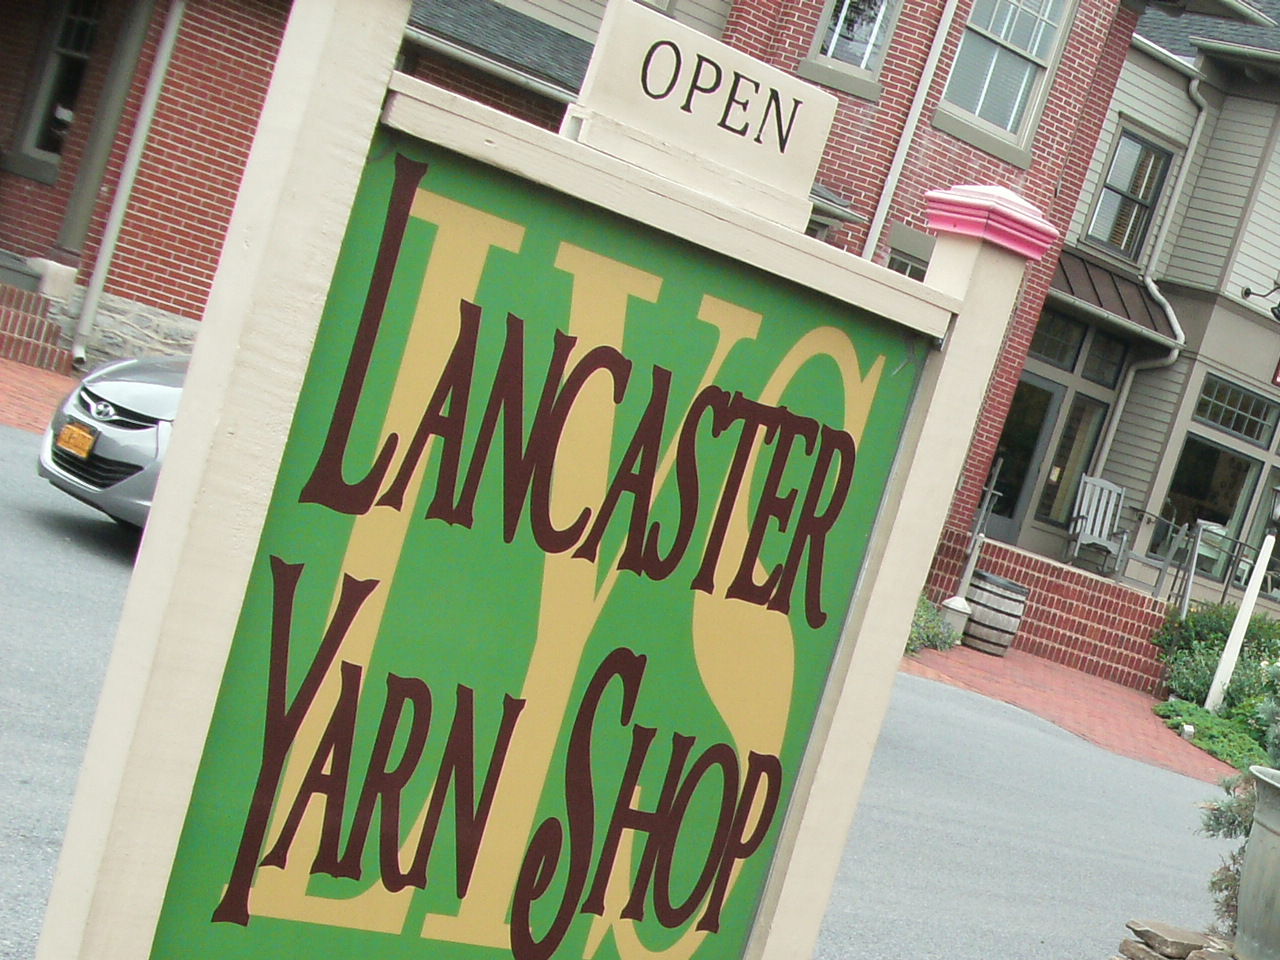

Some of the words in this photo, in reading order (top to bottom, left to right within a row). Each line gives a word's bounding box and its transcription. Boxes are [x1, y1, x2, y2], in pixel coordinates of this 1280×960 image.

[641, 40, 804, 154] OPEN
[298, 152, 856, 630] LANCASTER
[210, 554, 527, 927] YARN
